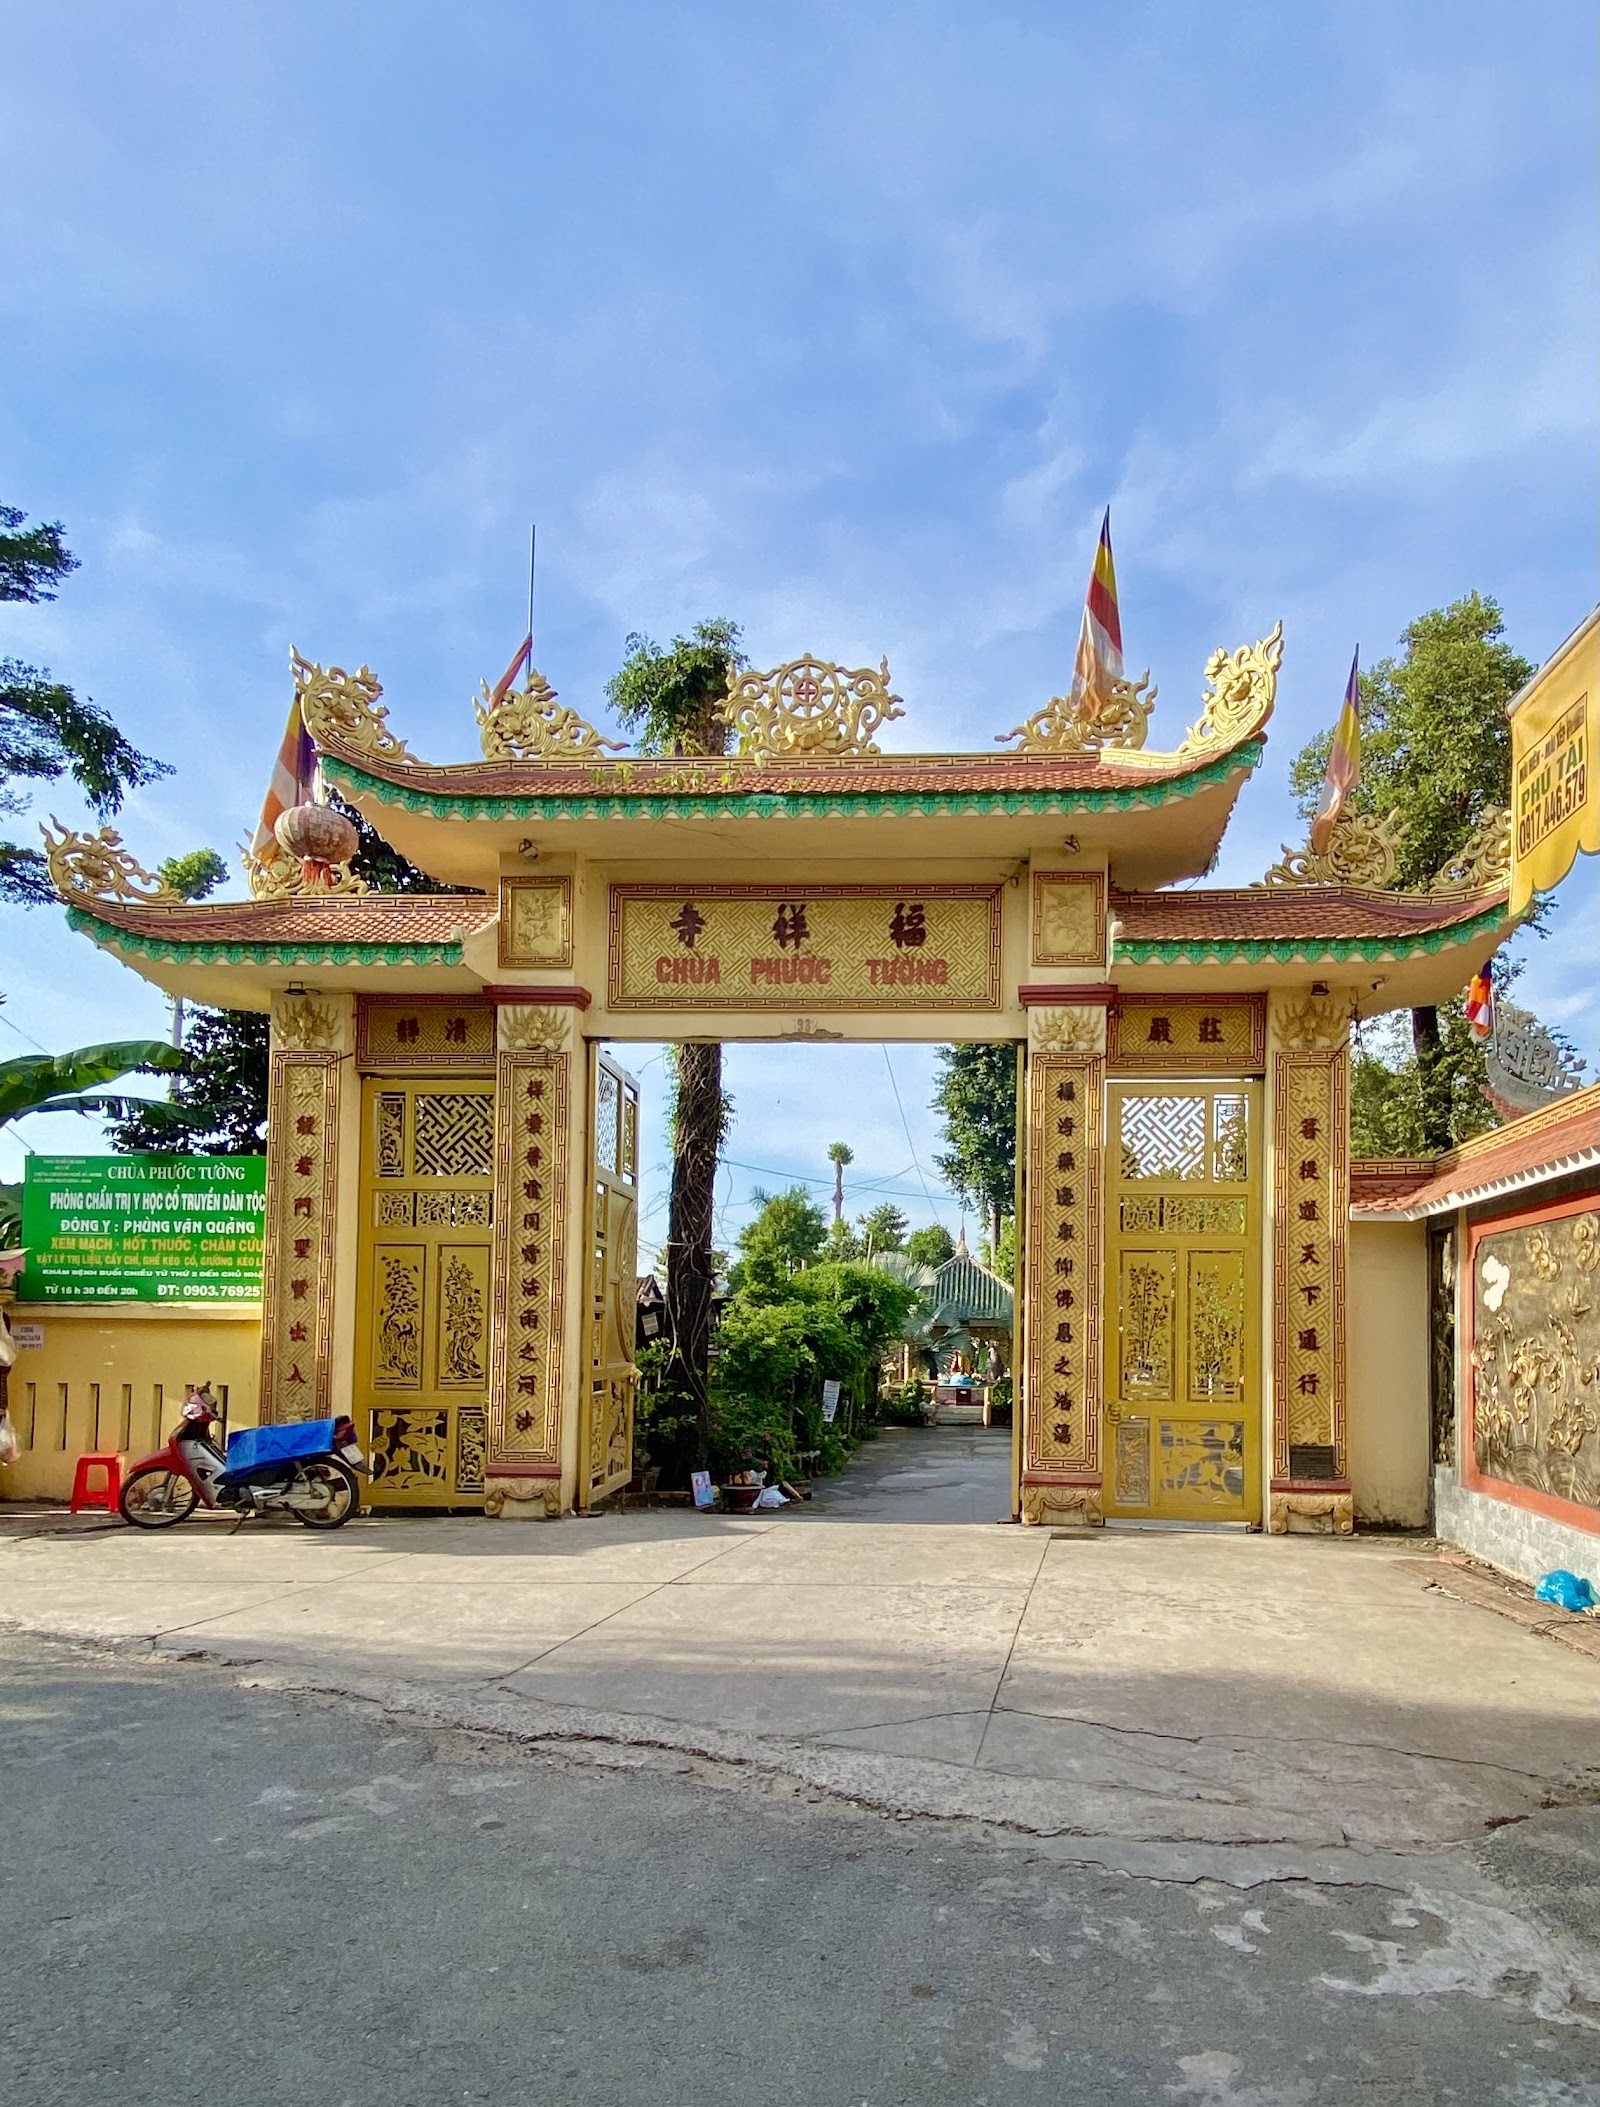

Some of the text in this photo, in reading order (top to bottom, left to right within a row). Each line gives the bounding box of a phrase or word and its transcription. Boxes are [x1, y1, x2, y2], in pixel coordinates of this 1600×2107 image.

[1521, 763, 1552, 816] PHÚ
[1556, 736, 1584, 781] TÀI
[1519, 764, 1585, 855] 0917.446.579
[107, 1161, 245, 1180] CHÙA PHƯỚC TƯỜNG
[50, 1187, 83, 1210] PHÒNG
[85, 1184, 113, 1210] CHẨN
[115, 1193, 131, 1215] TRỊ
[133, 1193, 140, 1210] Y
[142, 1192, 163, 1215] HỌC
[165, 1184, 180, 1211] CỔ
[223, 1189, 244, 1211] DÂN
[246, 1189, 266, 1216] TỘC
[60, 1216, 99, 1232] ĐÔNG
[102, 1220, 111, 1232] Y
[123, 1216, 170, 1233] PHÙNG
[173, 1218, 202, 1233] VĂN
[206, 1216, 255, 1234] QUẢNG
[51, 1237, 75, 1250] XEM
[79, 1237, 113, 1253] MẠCH
[123, 1234, 147, 1251] HỐT
[151, 1234, 191, 1251] THUỐC
[200, 1236, 236, 1251] CHÂM
[36, 1253, 53, 1266] VẬT
[45, 1284, 58, 1294] TỪ
[83, 1287, 95, 1295] 30
[97, 1284, 118, 1295] ĐẾN
[157, 1285, 180, 1296] ĐT:
